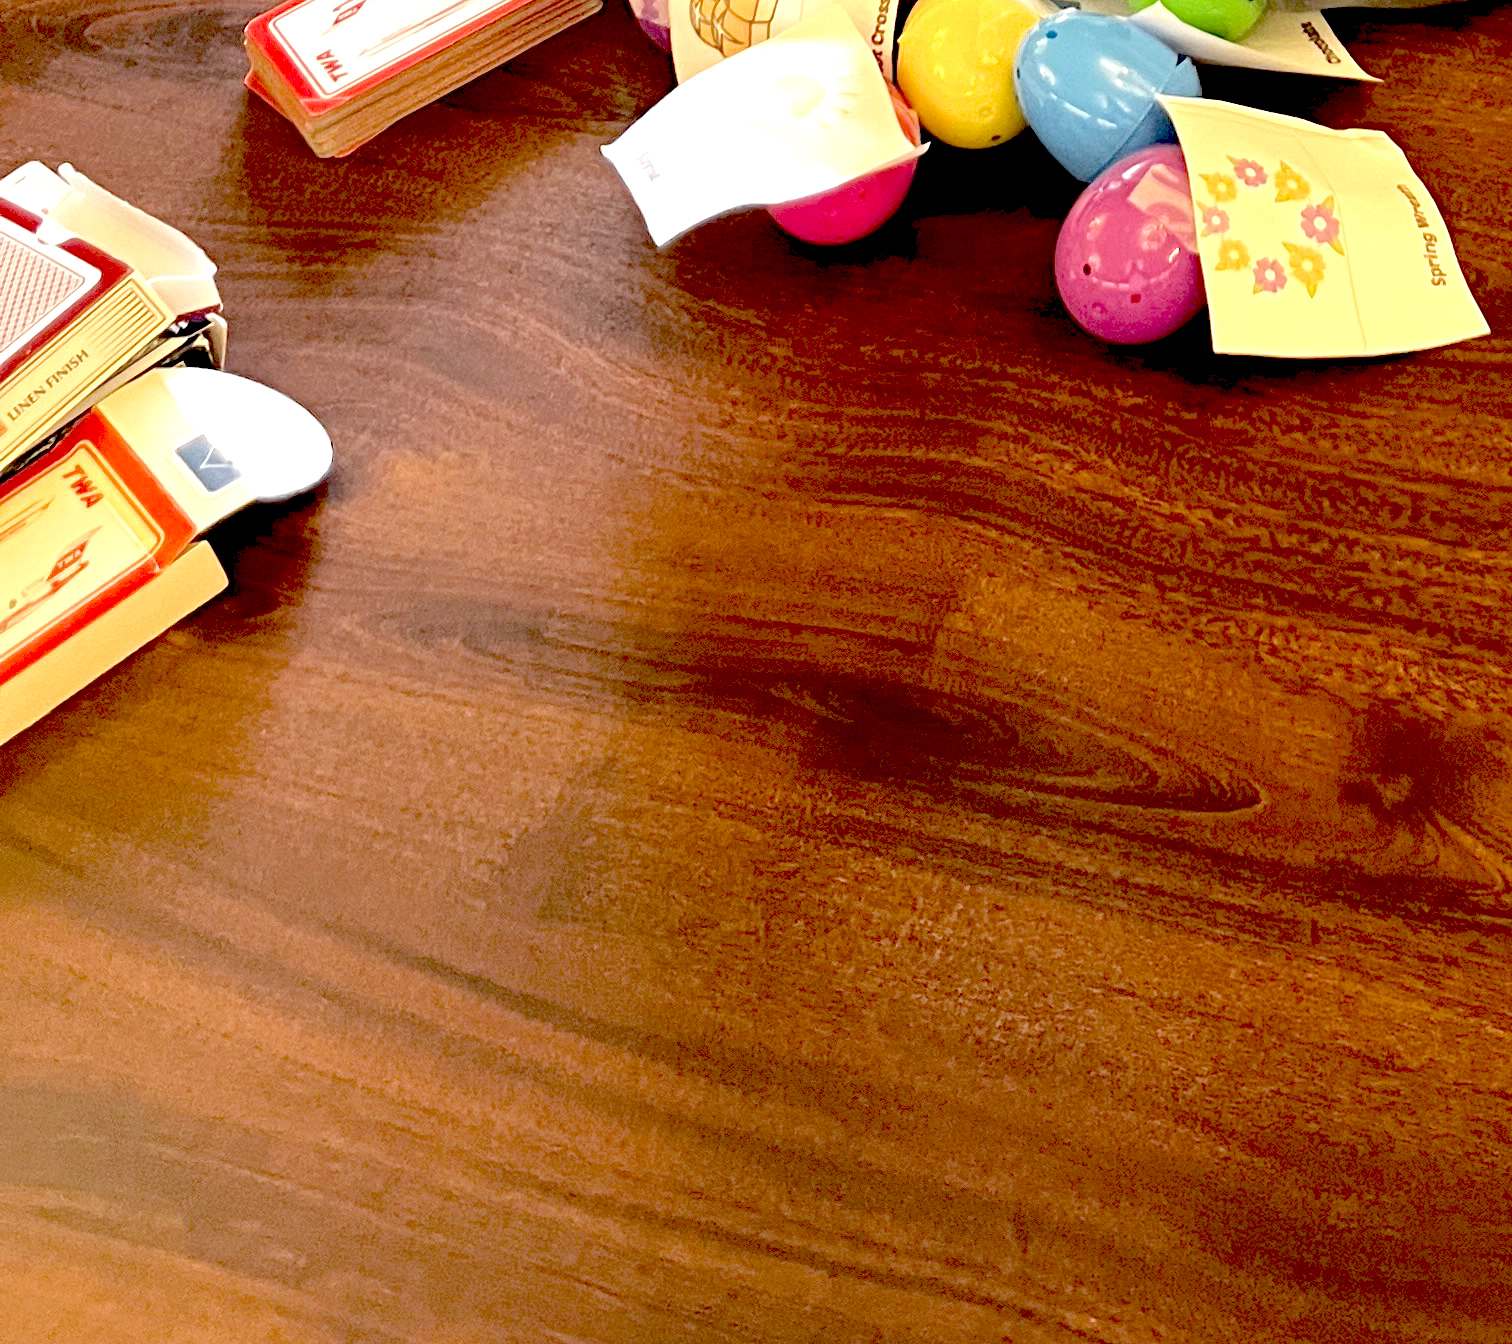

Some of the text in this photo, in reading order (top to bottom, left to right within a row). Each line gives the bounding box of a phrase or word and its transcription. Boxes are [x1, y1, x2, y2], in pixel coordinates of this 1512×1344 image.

[316, 49, 349, 82] TWA
[1422, 231, 1448, 287] Spring
[6, 349, 90, 422] LINEN FINISH
[62, 464, 105, 509] TWA
